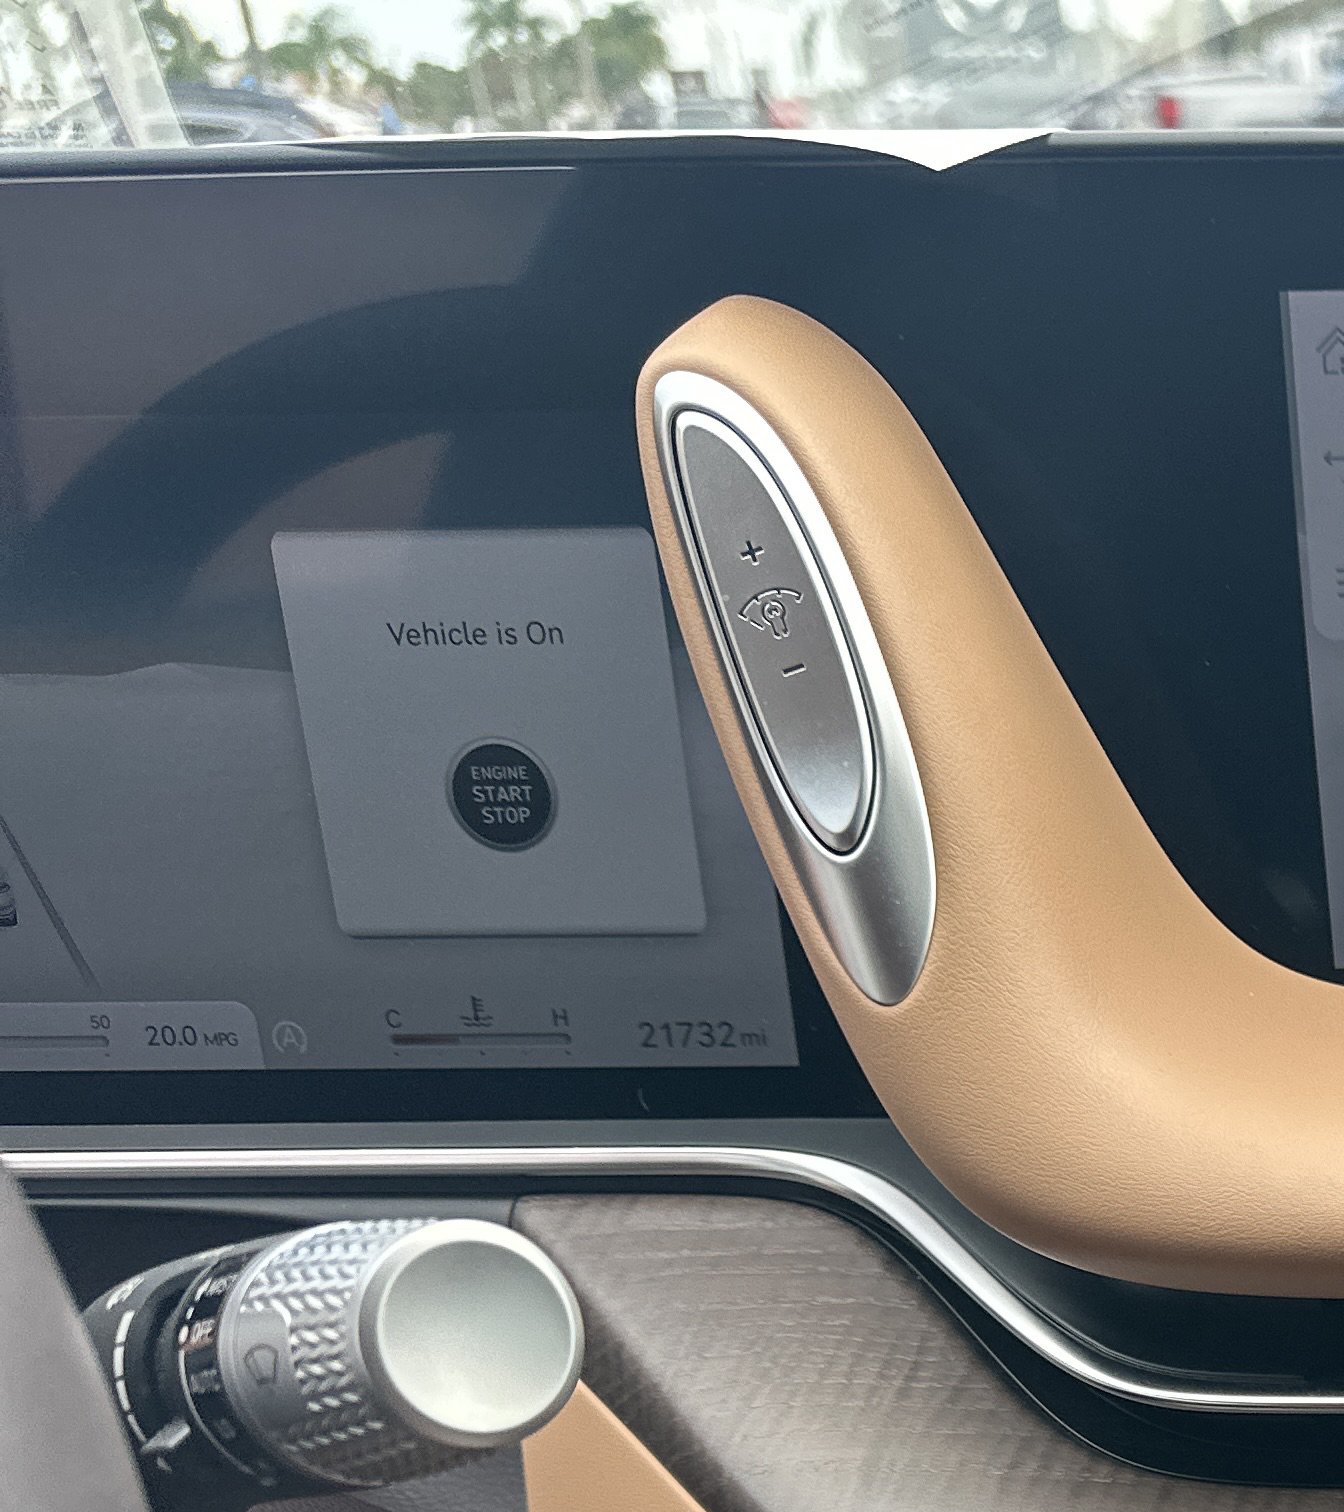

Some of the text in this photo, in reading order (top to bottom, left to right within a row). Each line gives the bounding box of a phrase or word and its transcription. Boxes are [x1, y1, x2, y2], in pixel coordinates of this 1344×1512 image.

[385, 620, 564, 647] Vehicle is On
[470, 765, 529, 781] ENGINE
[471, 785, 533, 803] START
[481, 806, 531, 824] STOP
[89, 1014, 111, 1030] 50
[144, 1024, 239, 1047] 20.0 MPG
